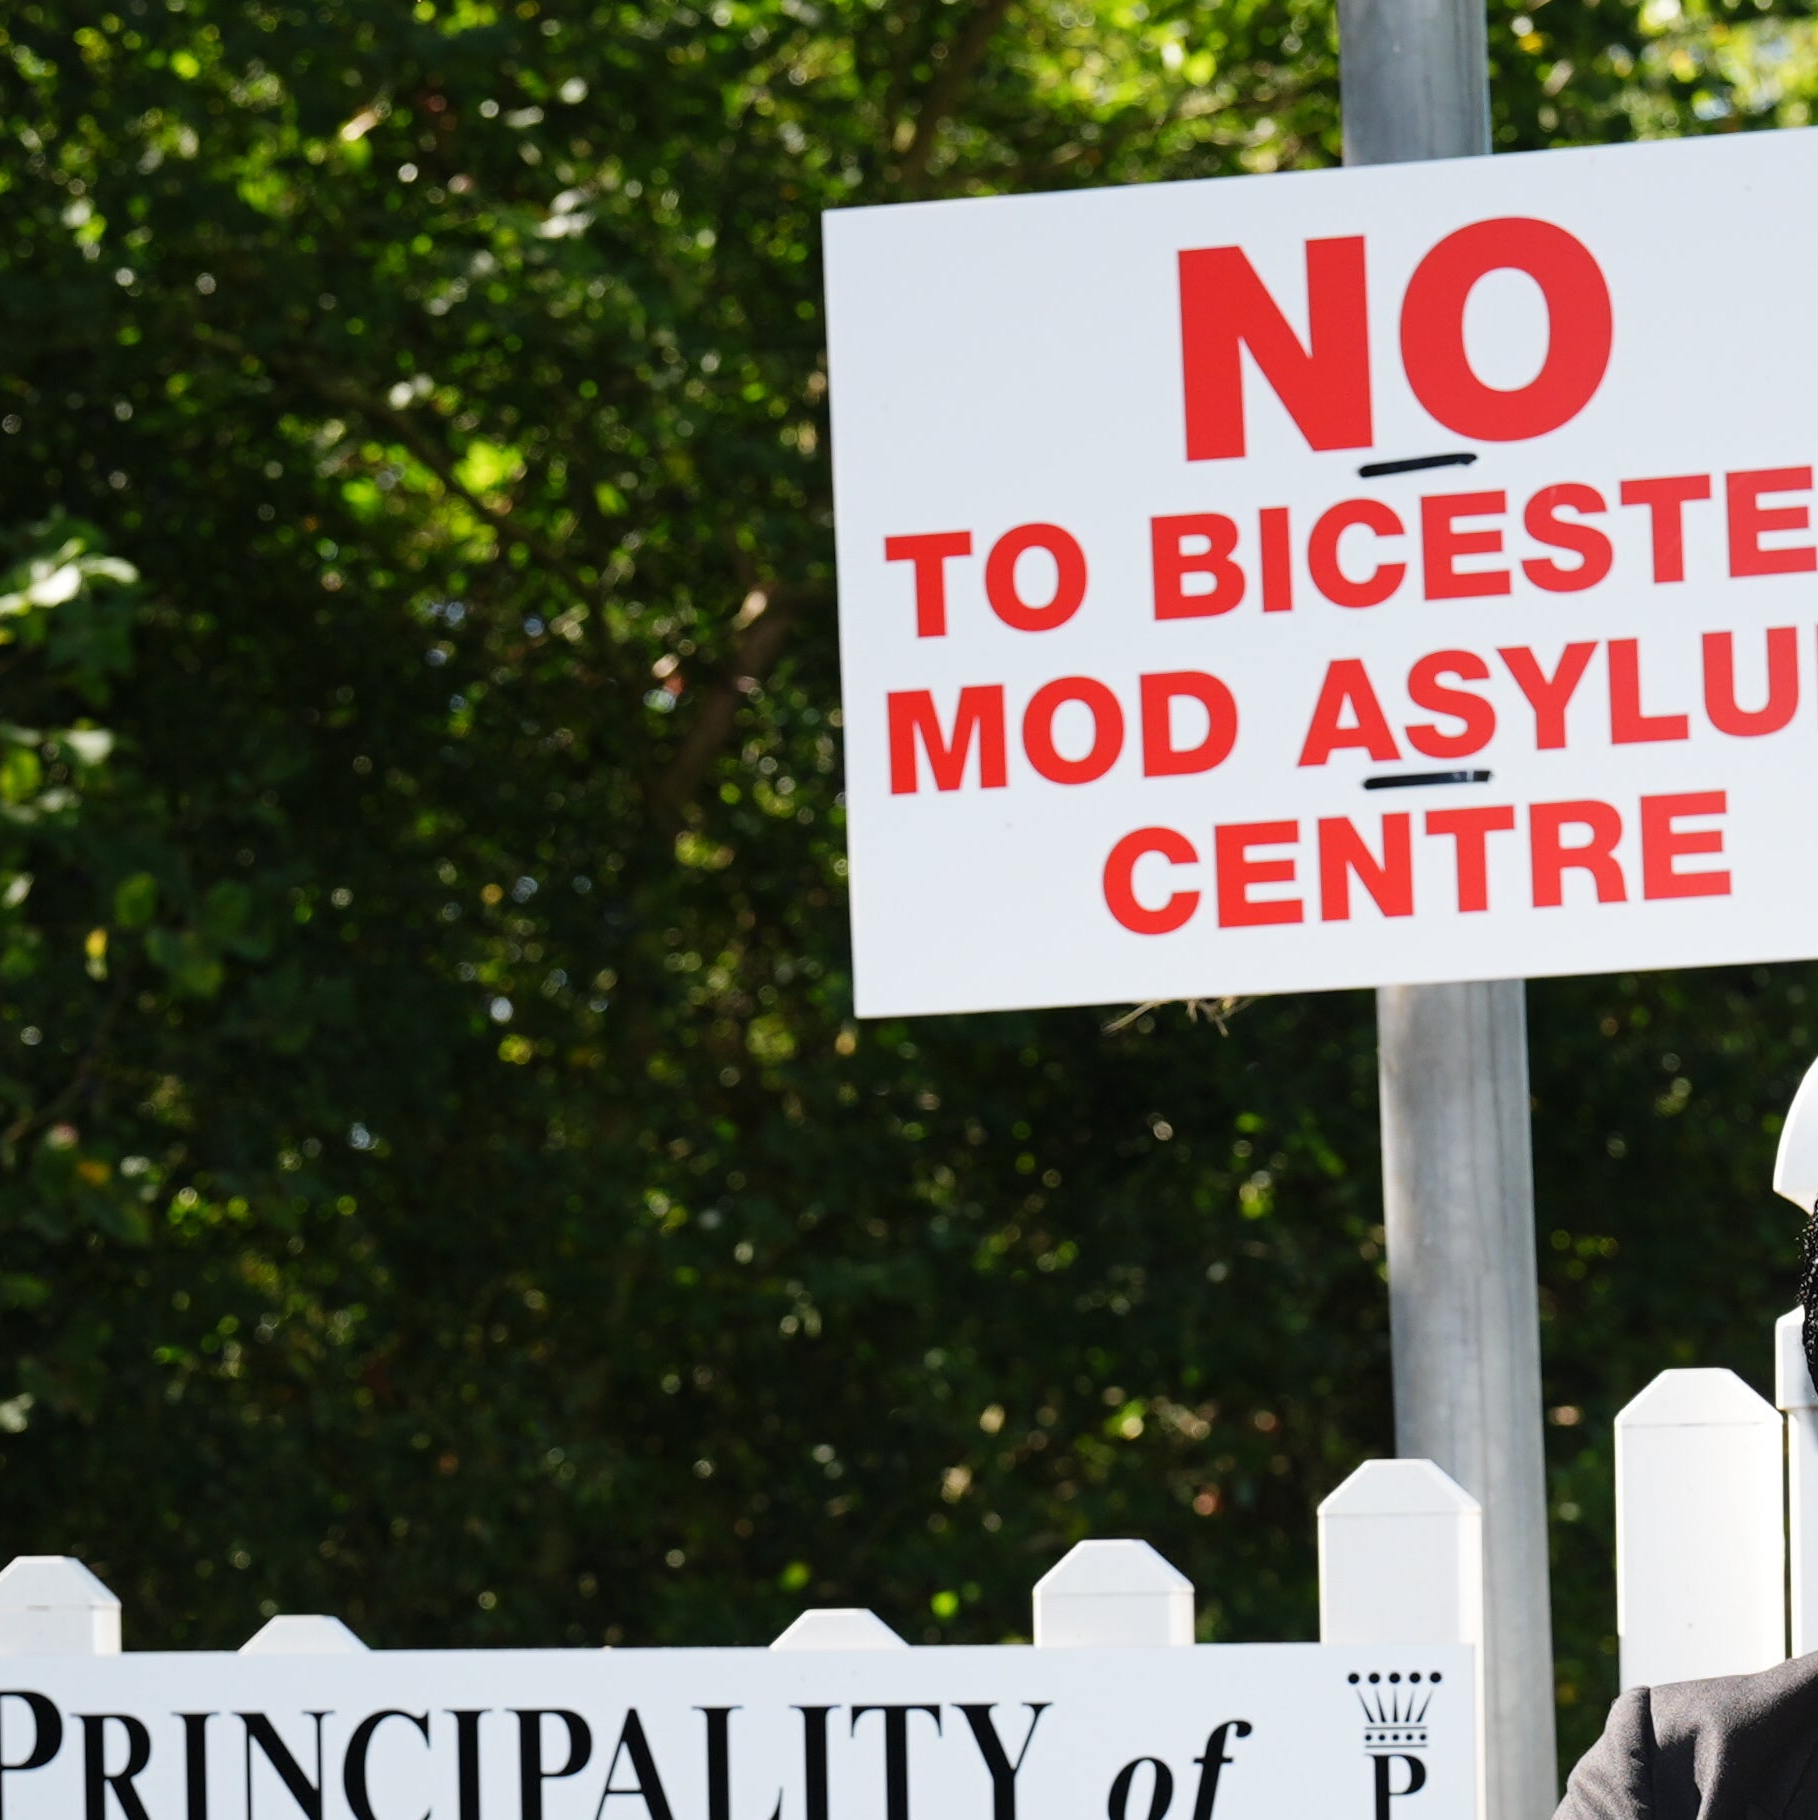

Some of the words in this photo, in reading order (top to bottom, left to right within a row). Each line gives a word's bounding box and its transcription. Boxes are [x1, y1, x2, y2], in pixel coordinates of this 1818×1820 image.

[1177, 216, 1615, 462] NO
[884, 522, 1089, 639] TO
[885, 670, 1240, 796] MOD
[1102, 790, 1733, 937] CENTRE
